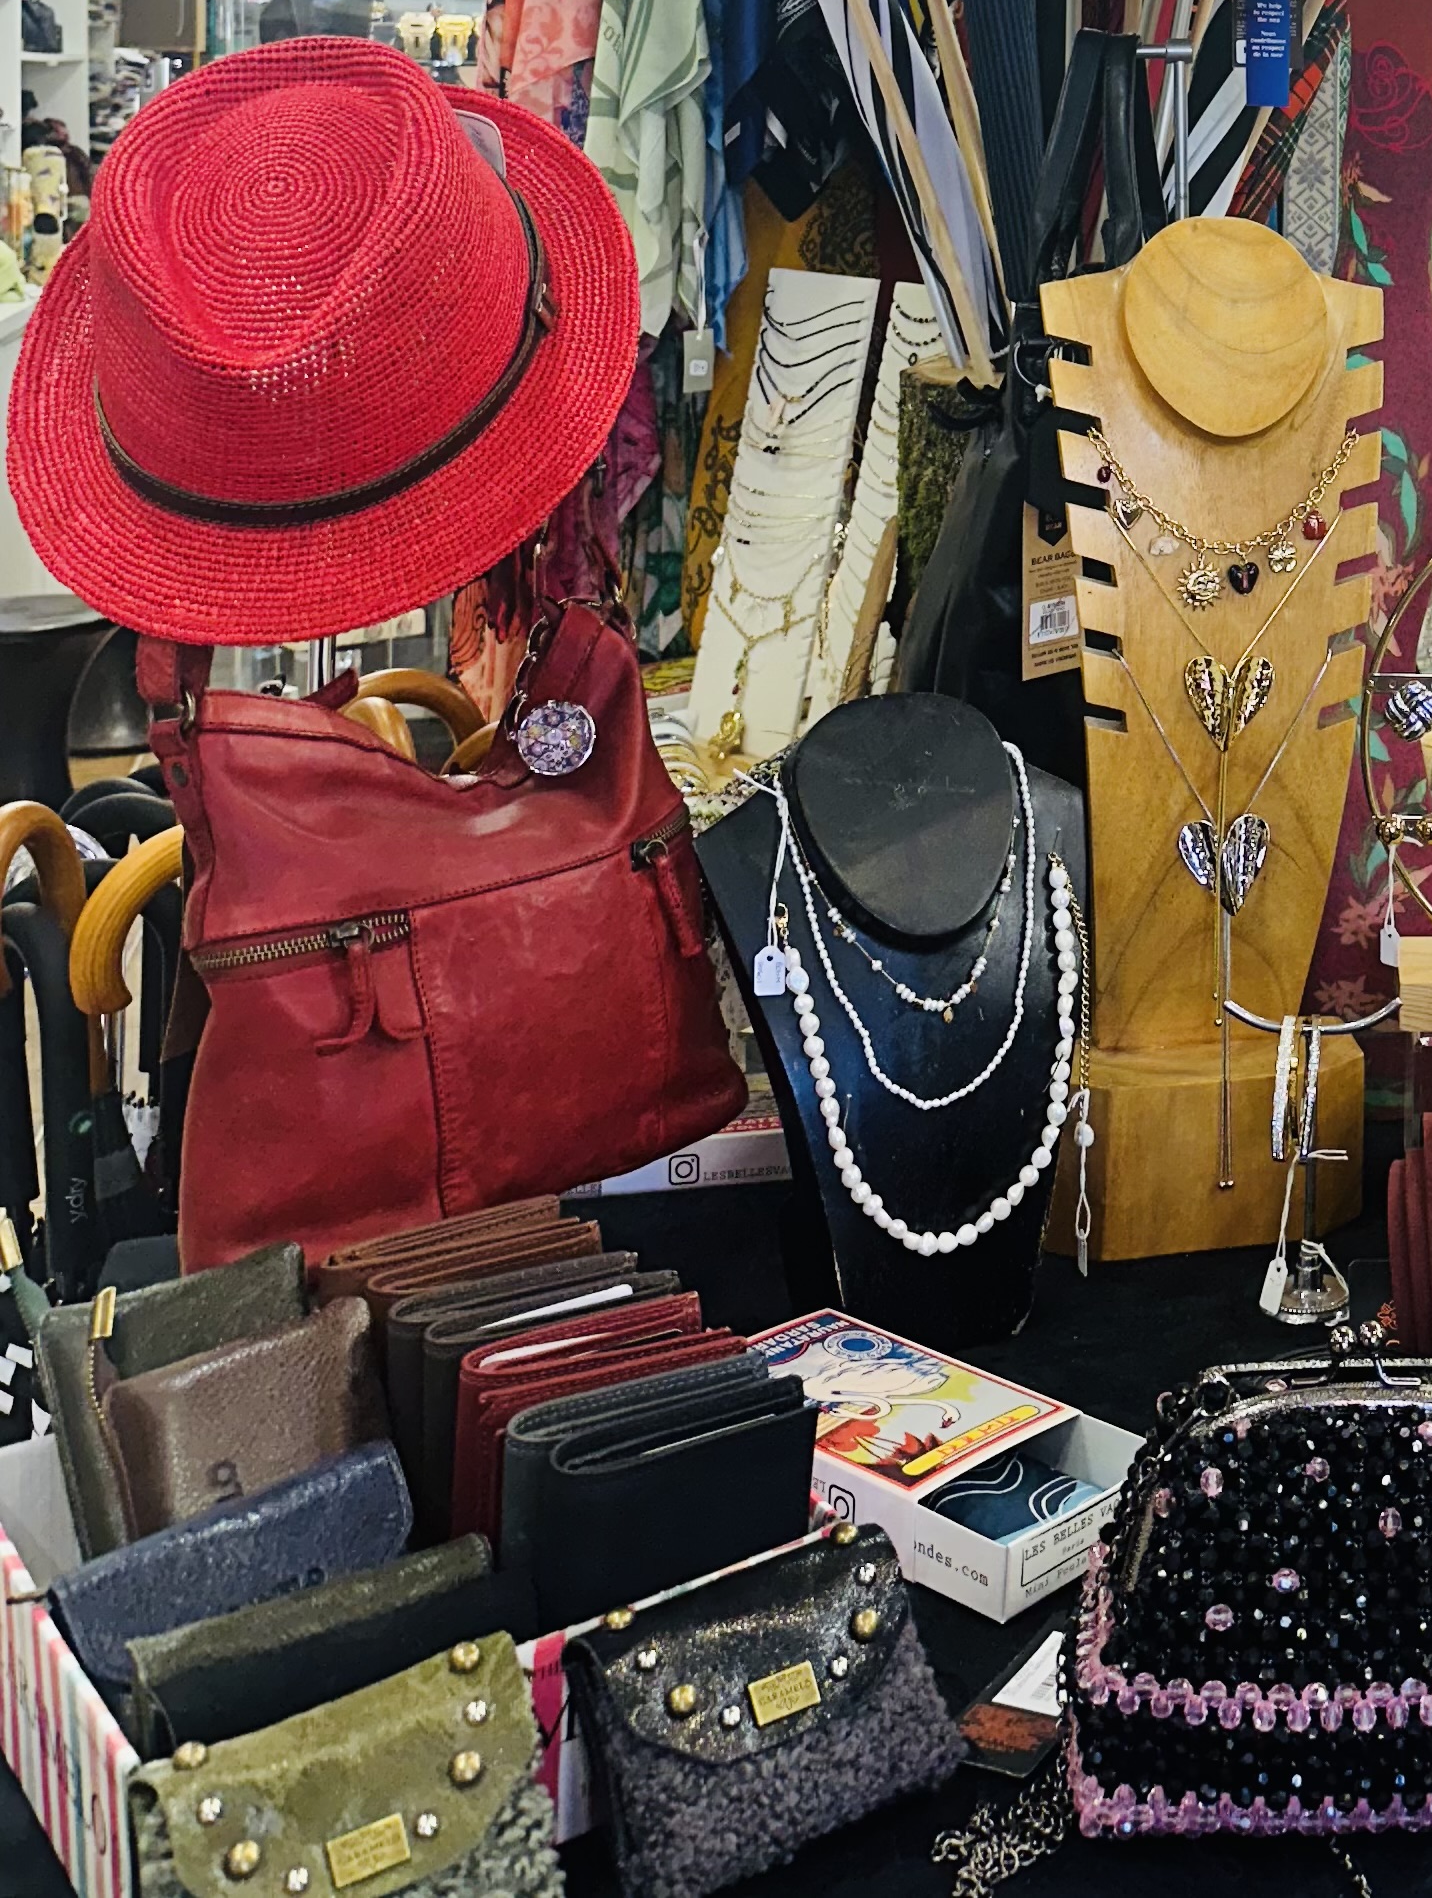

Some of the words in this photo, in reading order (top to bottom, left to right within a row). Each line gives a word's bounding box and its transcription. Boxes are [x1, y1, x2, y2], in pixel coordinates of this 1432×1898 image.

[65, 1177, 88, 1224] ydry
[1024, 1540, 1046, 1561] LES
[1053, 1513, 1094, 1546] BELLES
